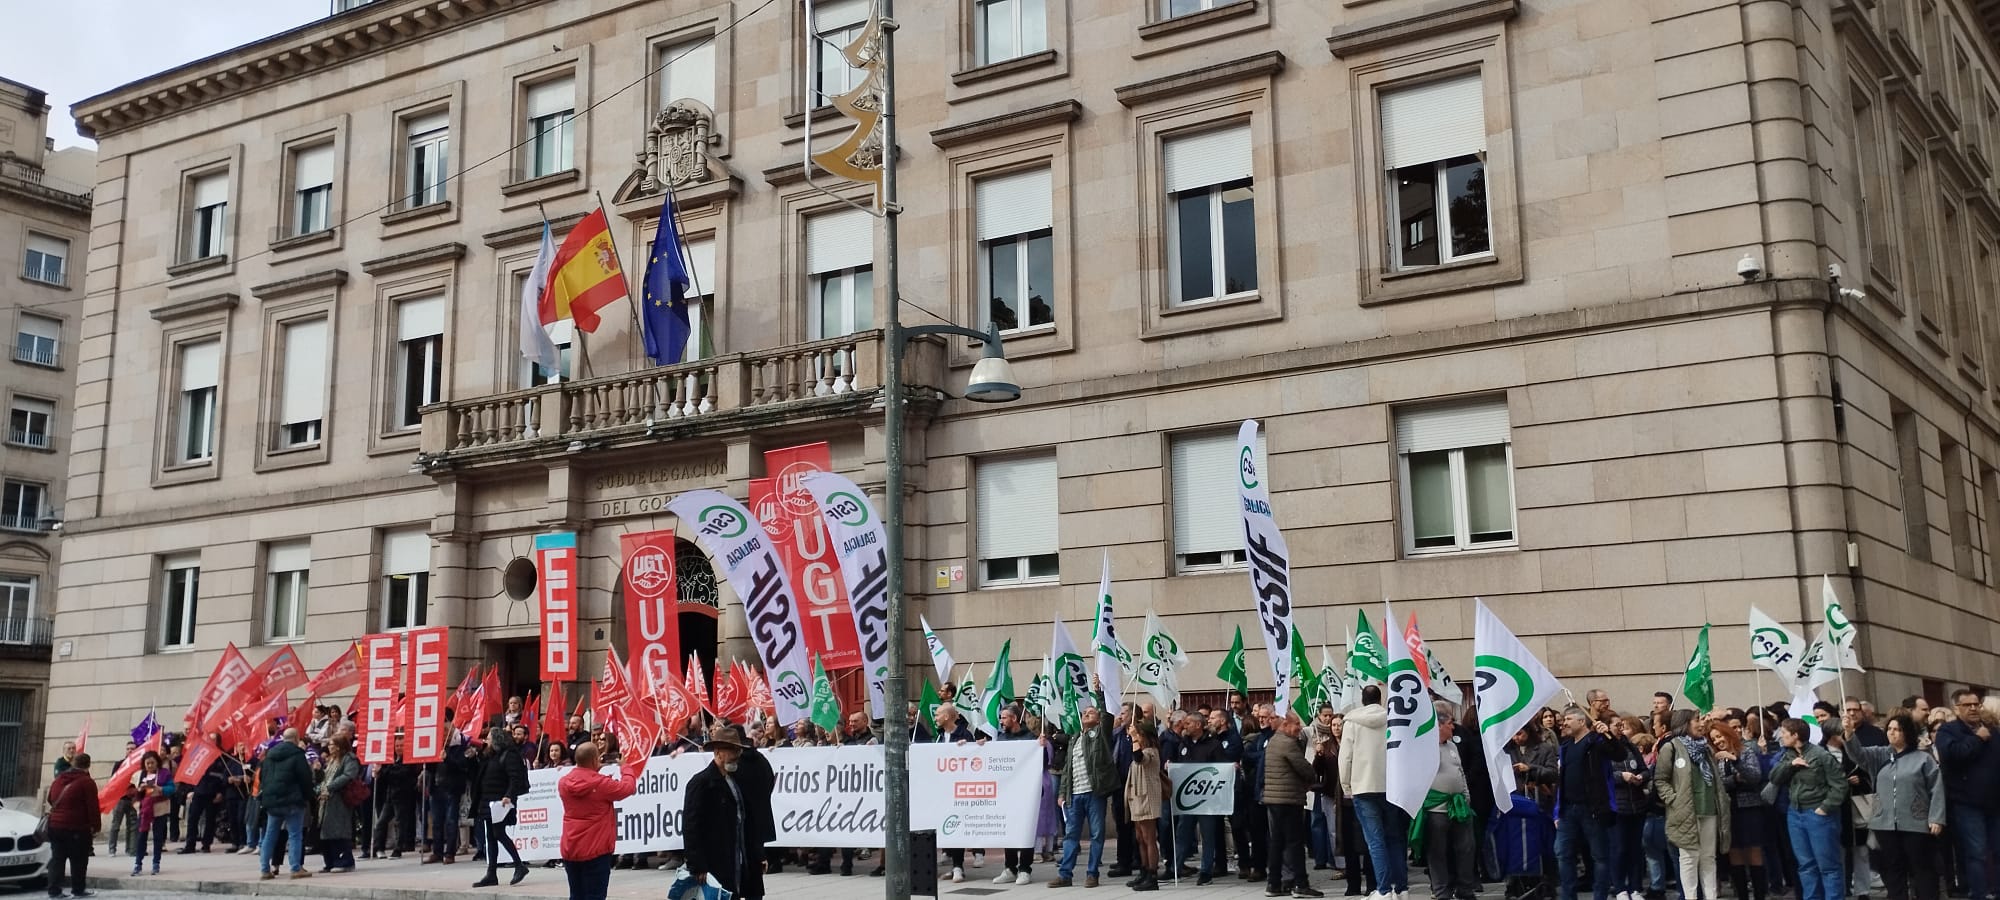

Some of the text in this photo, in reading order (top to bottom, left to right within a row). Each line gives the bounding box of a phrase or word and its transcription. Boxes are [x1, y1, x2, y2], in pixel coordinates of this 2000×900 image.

[597, 462, 728, 490] SUBDELEGACIÓN
[602, 501, 631, 517] DEL
[633, 554, 665, 575] UGT
[793, 515, 837, 651] UGT
[544, 549, 570, 673] CCOO
[639, 597, 668, 690] UG
[365, 638, 394, 762] CCOO
[413, 633, 440, 758] CCOO
[826, 763, 884, 793] Públic
[937, 756, 1016, 772] UGT Servicios
[635, 768, 678, 795] alario
[956, 783, 996, 797] CCOO
[970, 800, 997, 808] pública
[615, 804, 684, 845] Empleo
[515, 837, 529, 850] GT
